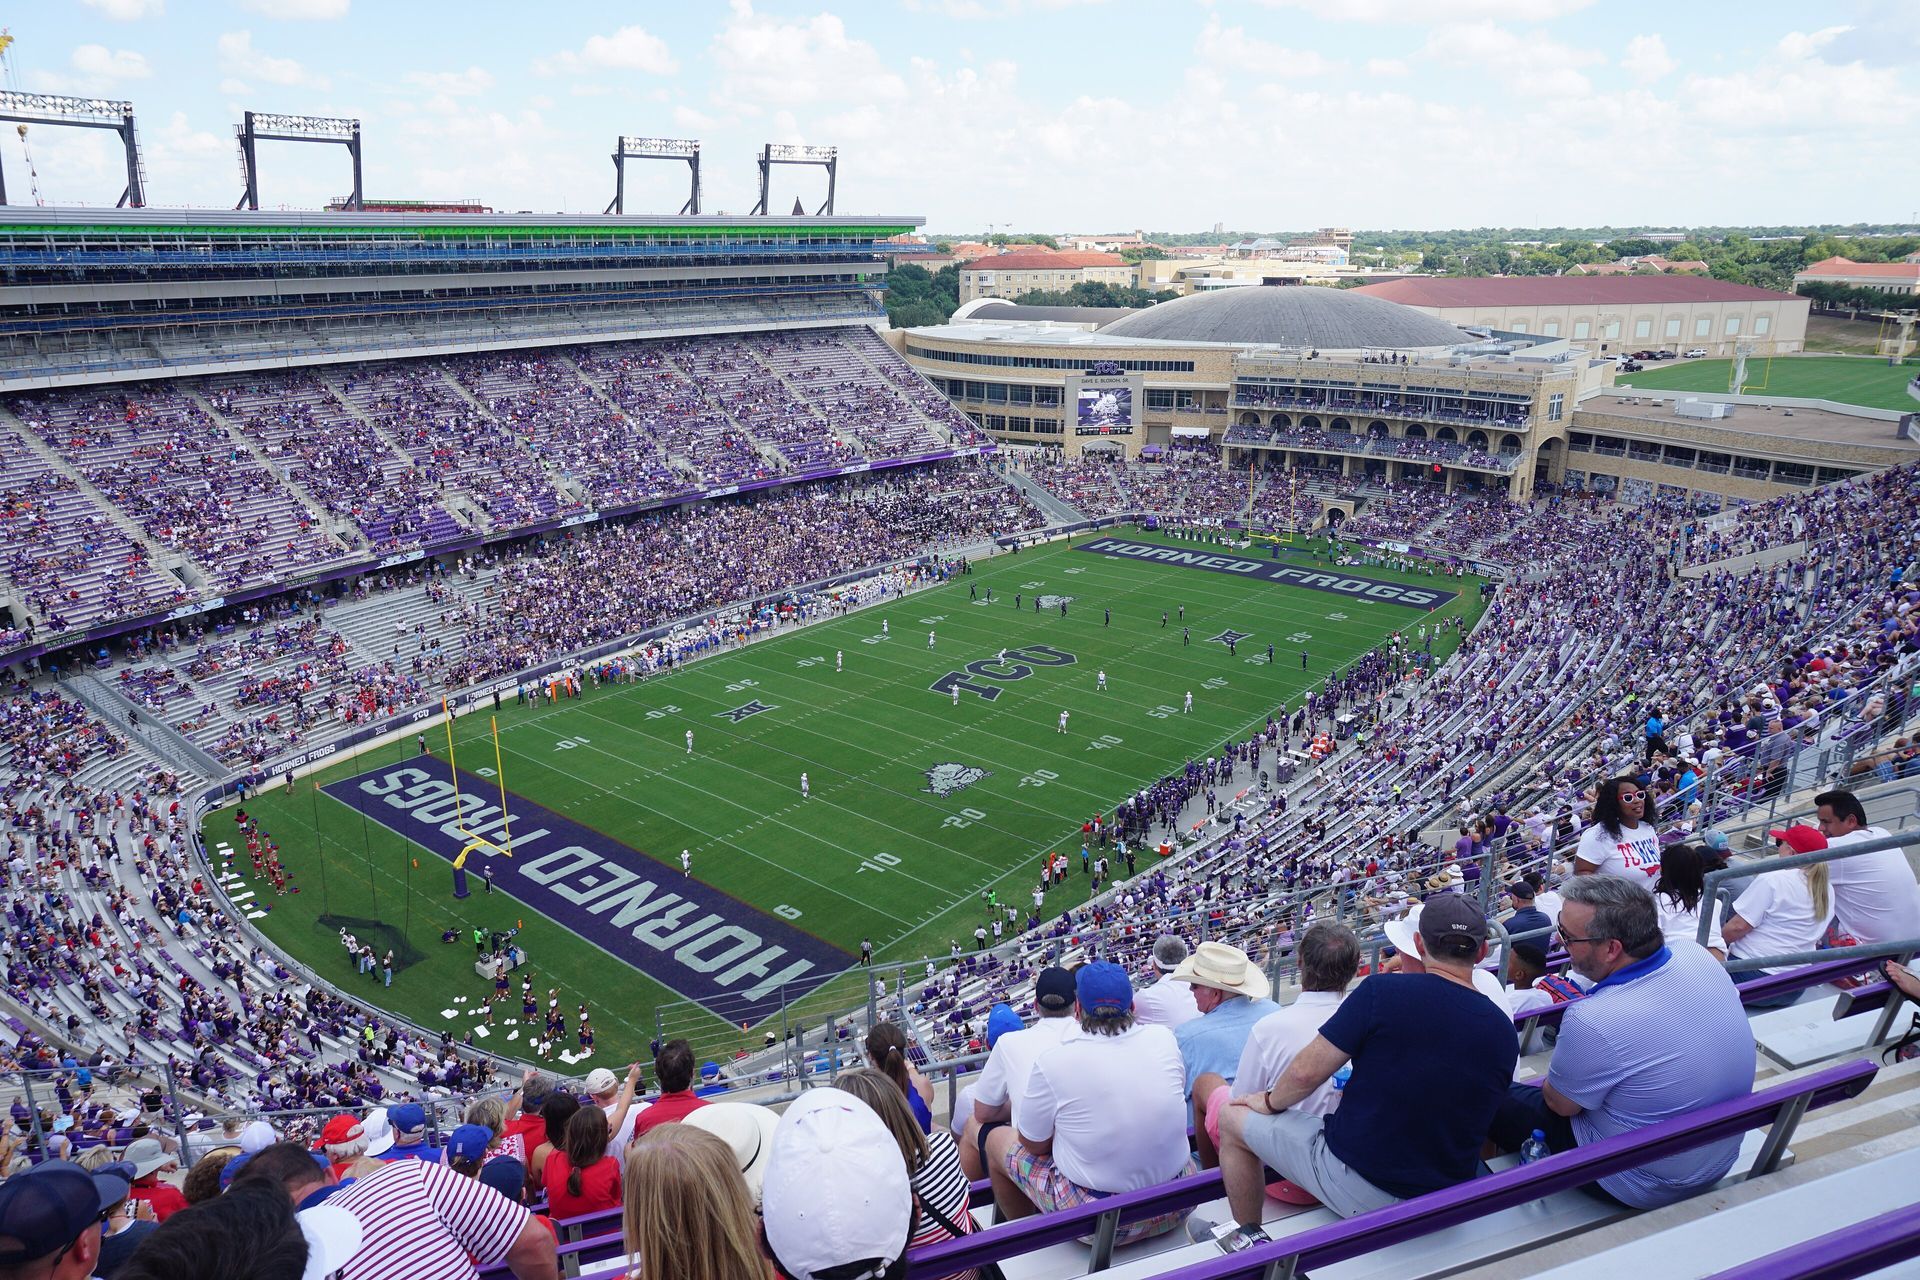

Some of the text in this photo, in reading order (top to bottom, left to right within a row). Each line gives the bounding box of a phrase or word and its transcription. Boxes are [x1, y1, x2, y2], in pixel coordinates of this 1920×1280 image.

[1094, 361, 1118, 375] TCU
[1089, 541, 1264, 573] HORNED
[1269, 568, 1439, 604] FROGS
[672, 623, 686, 633] TCU
[560, 658, 576, 669] TCU
[928, 644, 1078, 701] TCU
[495, 677, 518, 692] FROGS
[412, 708, 429, 722] TCU
[1145, 704, 1179, 719] 50
[1090, 734, 1124, 750] 40
[271, 743, 336, 776] HORNED FROGS
[1020, 768, 1060, 787] 30
[943, 807, 987, 829] 20
[860, 852, 902, 873] 10
[358, 768, 816, 1002] HORNED FROGS
[773, 904, 802, 920] G
[1451, 923, 1468, 931] SMU
